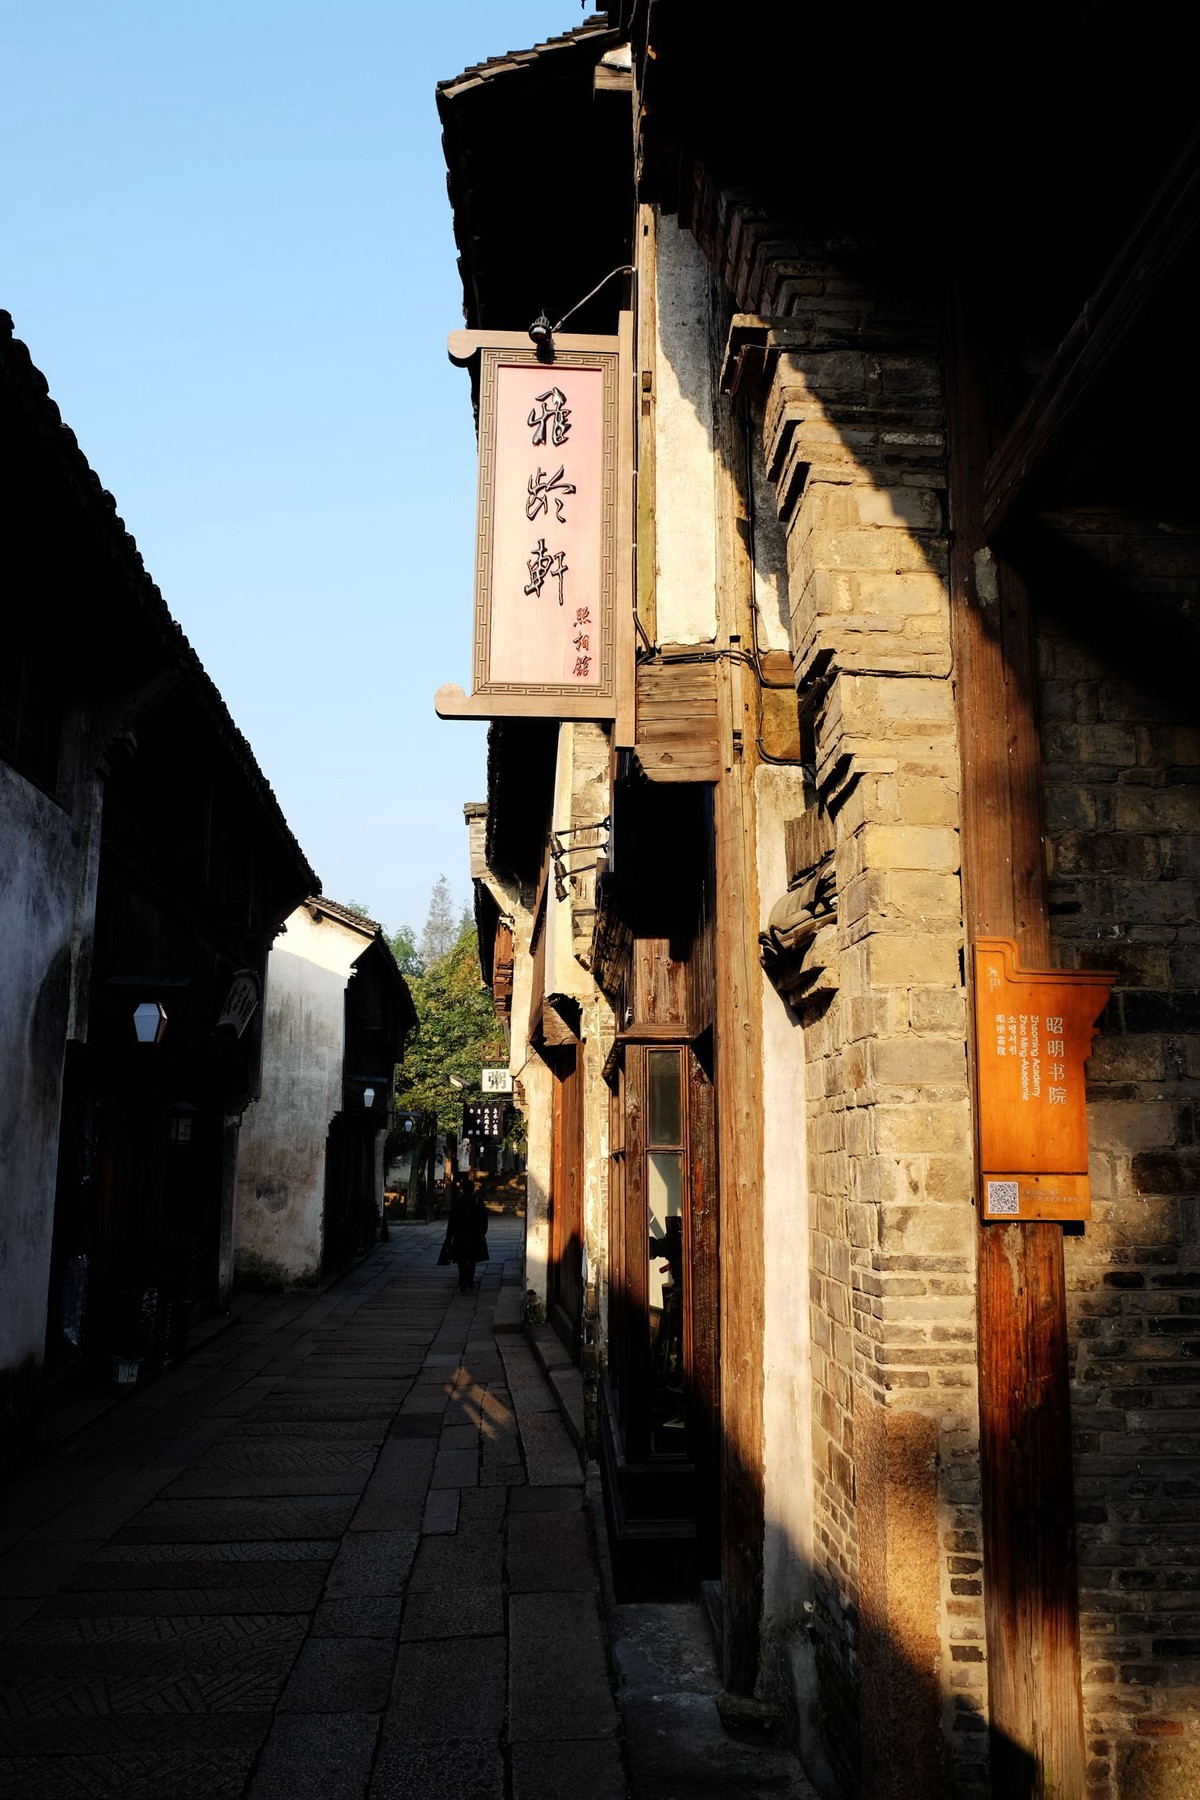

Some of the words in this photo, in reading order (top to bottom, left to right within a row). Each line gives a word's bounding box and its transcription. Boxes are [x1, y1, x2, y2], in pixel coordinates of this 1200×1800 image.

[1019, 1014, 1028, 1036] Zhao
[1030, 1015, 1040, 1057] Zhaoming
[488, 1070, 507, 1090] 粥
[1032, 1058, 1042, 1098] Academy
[1046, 1016, 1068, 1105] 昭明书院
